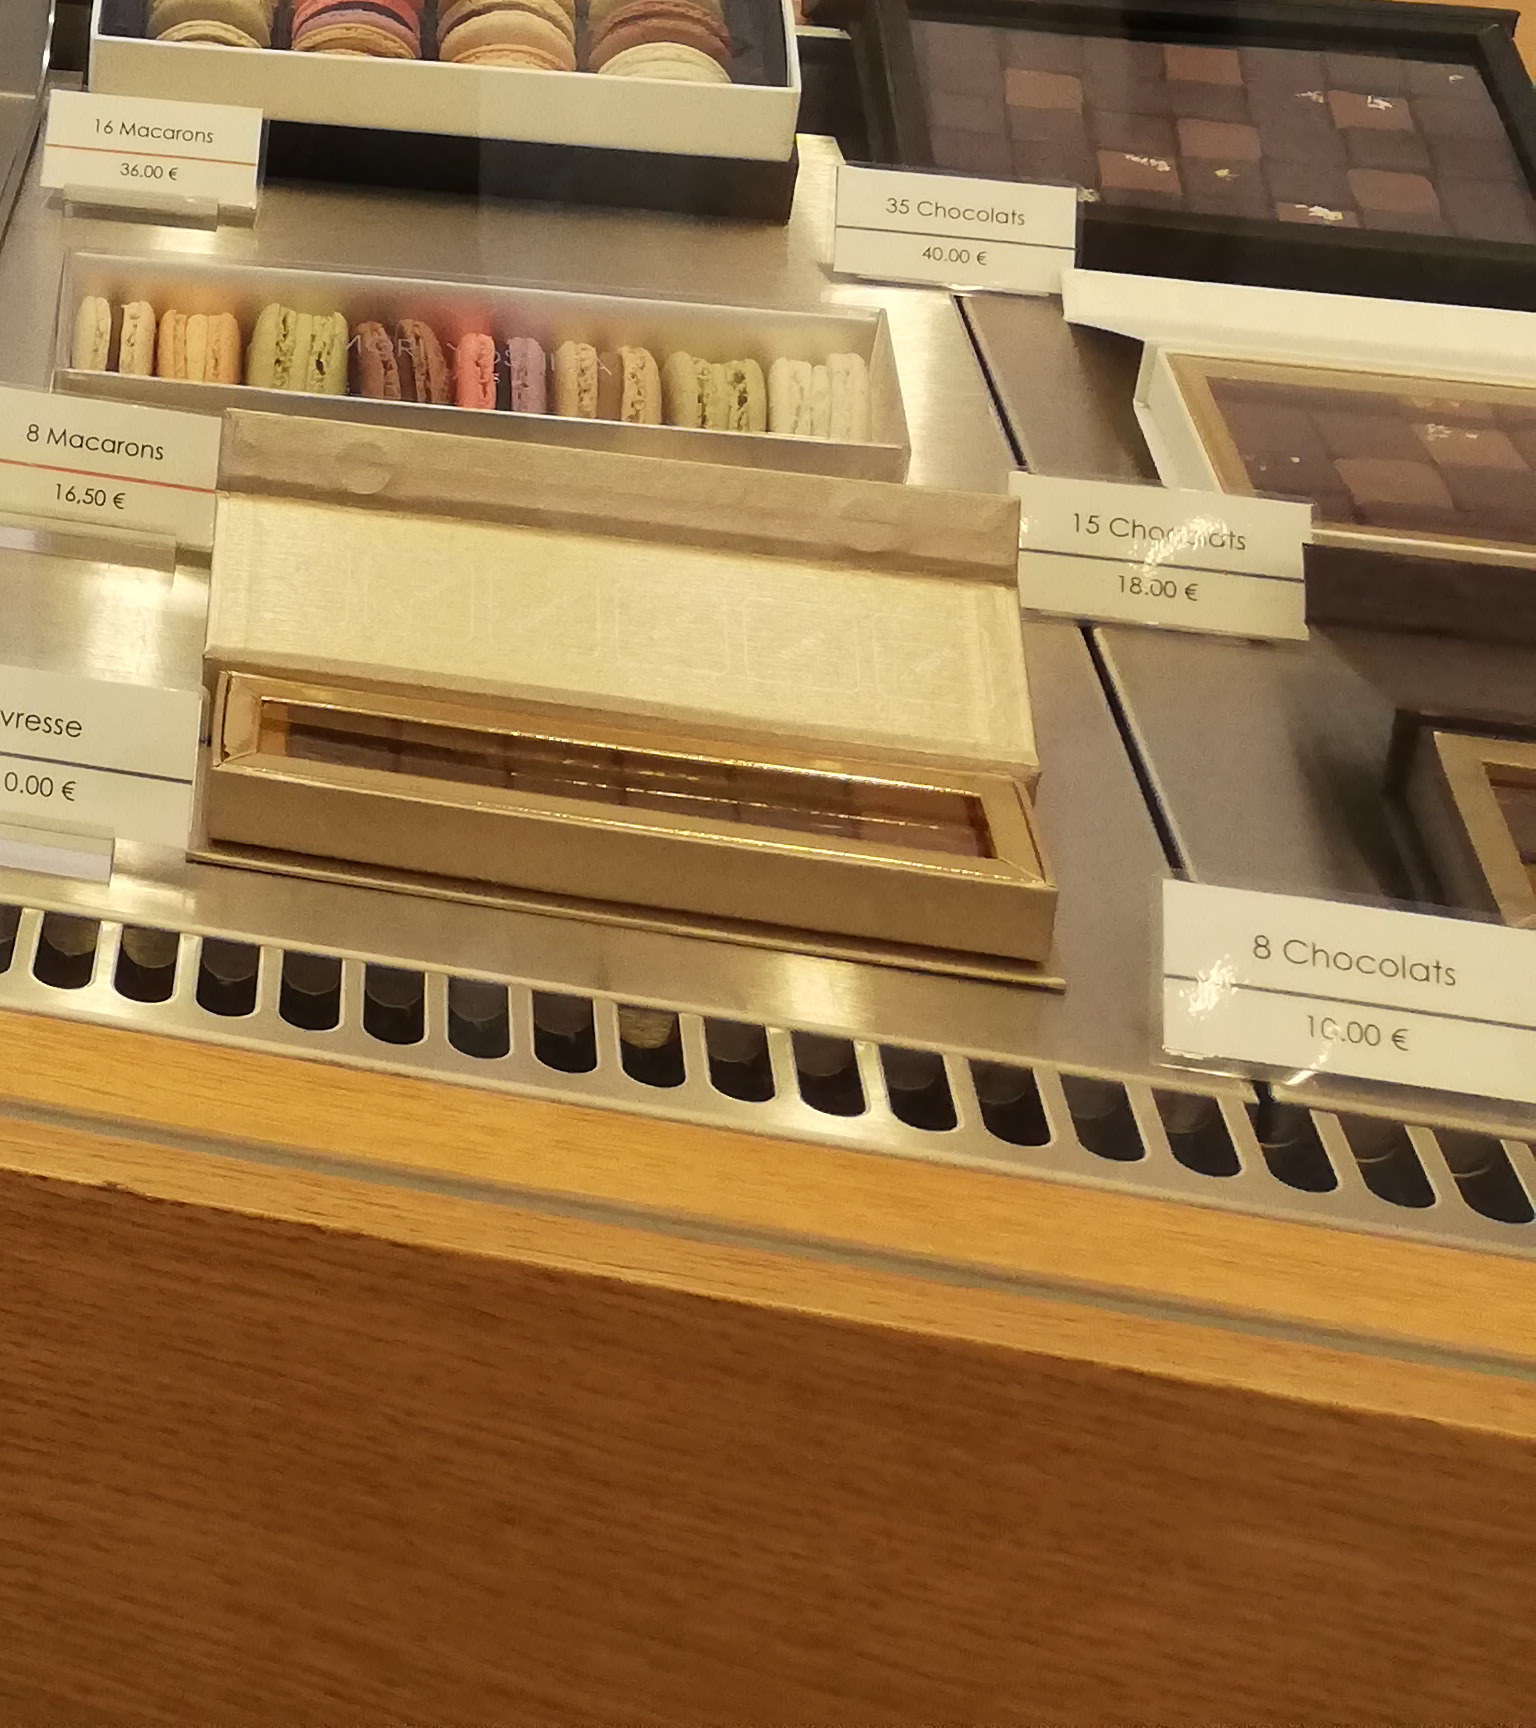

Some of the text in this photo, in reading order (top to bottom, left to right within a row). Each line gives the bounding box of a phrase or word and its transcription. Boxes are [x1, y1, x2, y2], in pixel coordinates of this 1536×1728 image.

[95, 118, 214, 144] 16 Macarons
[120, 162, 179, 181] 36.00 €
[885, 197, 1025, 226] 35 Chocolats
[922, 246, 988, 266] 40.00 €
[26, 423, 164, 461] 8 Macarons
[113, 492, 126, 510] €
[1073, 513, 1100, 535] 15
[1118, 575, 1199, 601] 18.00 €
[61, 780, 77, 802] €
[1253, 934, 1457, 987] 8 Chocolats
[1307, 1014, 1409, 1052] 10.00 €
